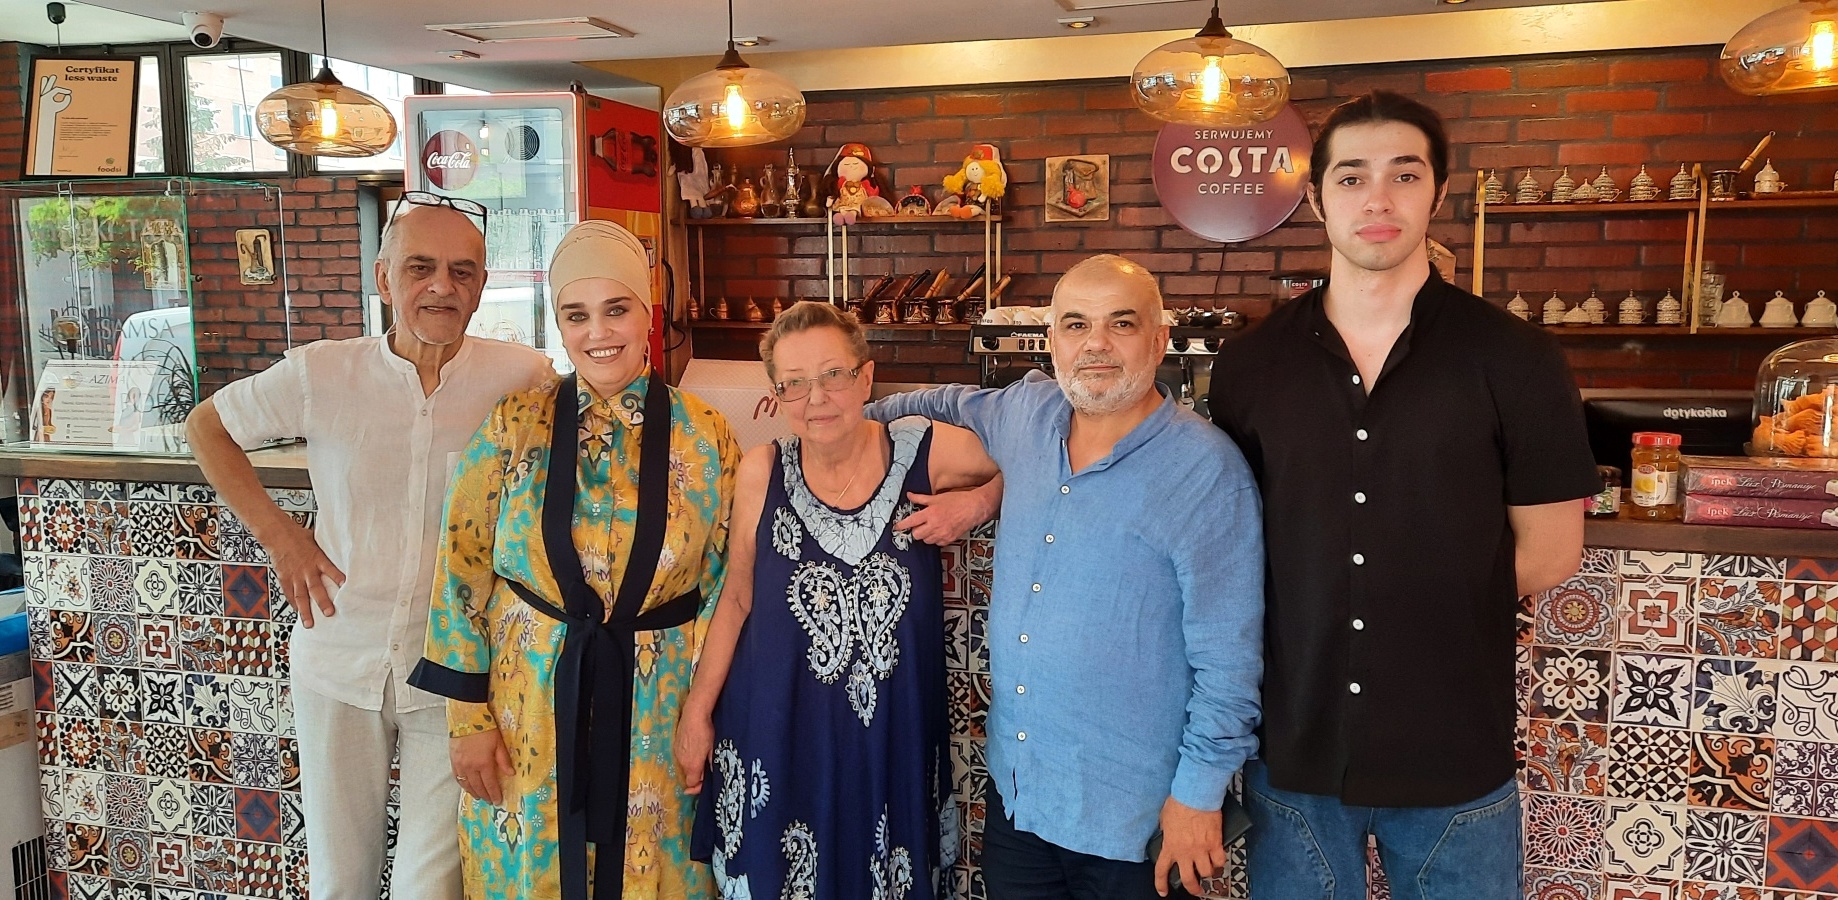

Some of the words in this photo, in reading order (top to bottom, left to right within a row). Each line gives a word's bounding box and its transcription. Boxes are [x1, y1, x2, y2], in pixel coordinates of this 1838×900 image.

[65, 65, 120, 75] Certyfikat
[64, 74, 86, 82] less
[1194, 129, 1274, 140] SERWUJEMY
[426, 151, 473, 169] Coca-Cola
[1170, 146, 1294, 178] COSTA
[97, 165, 122, 173] foodsi
[1197, 183, 1265, 195] COFFEE
[100, 317, 175, 340] SAMSA
